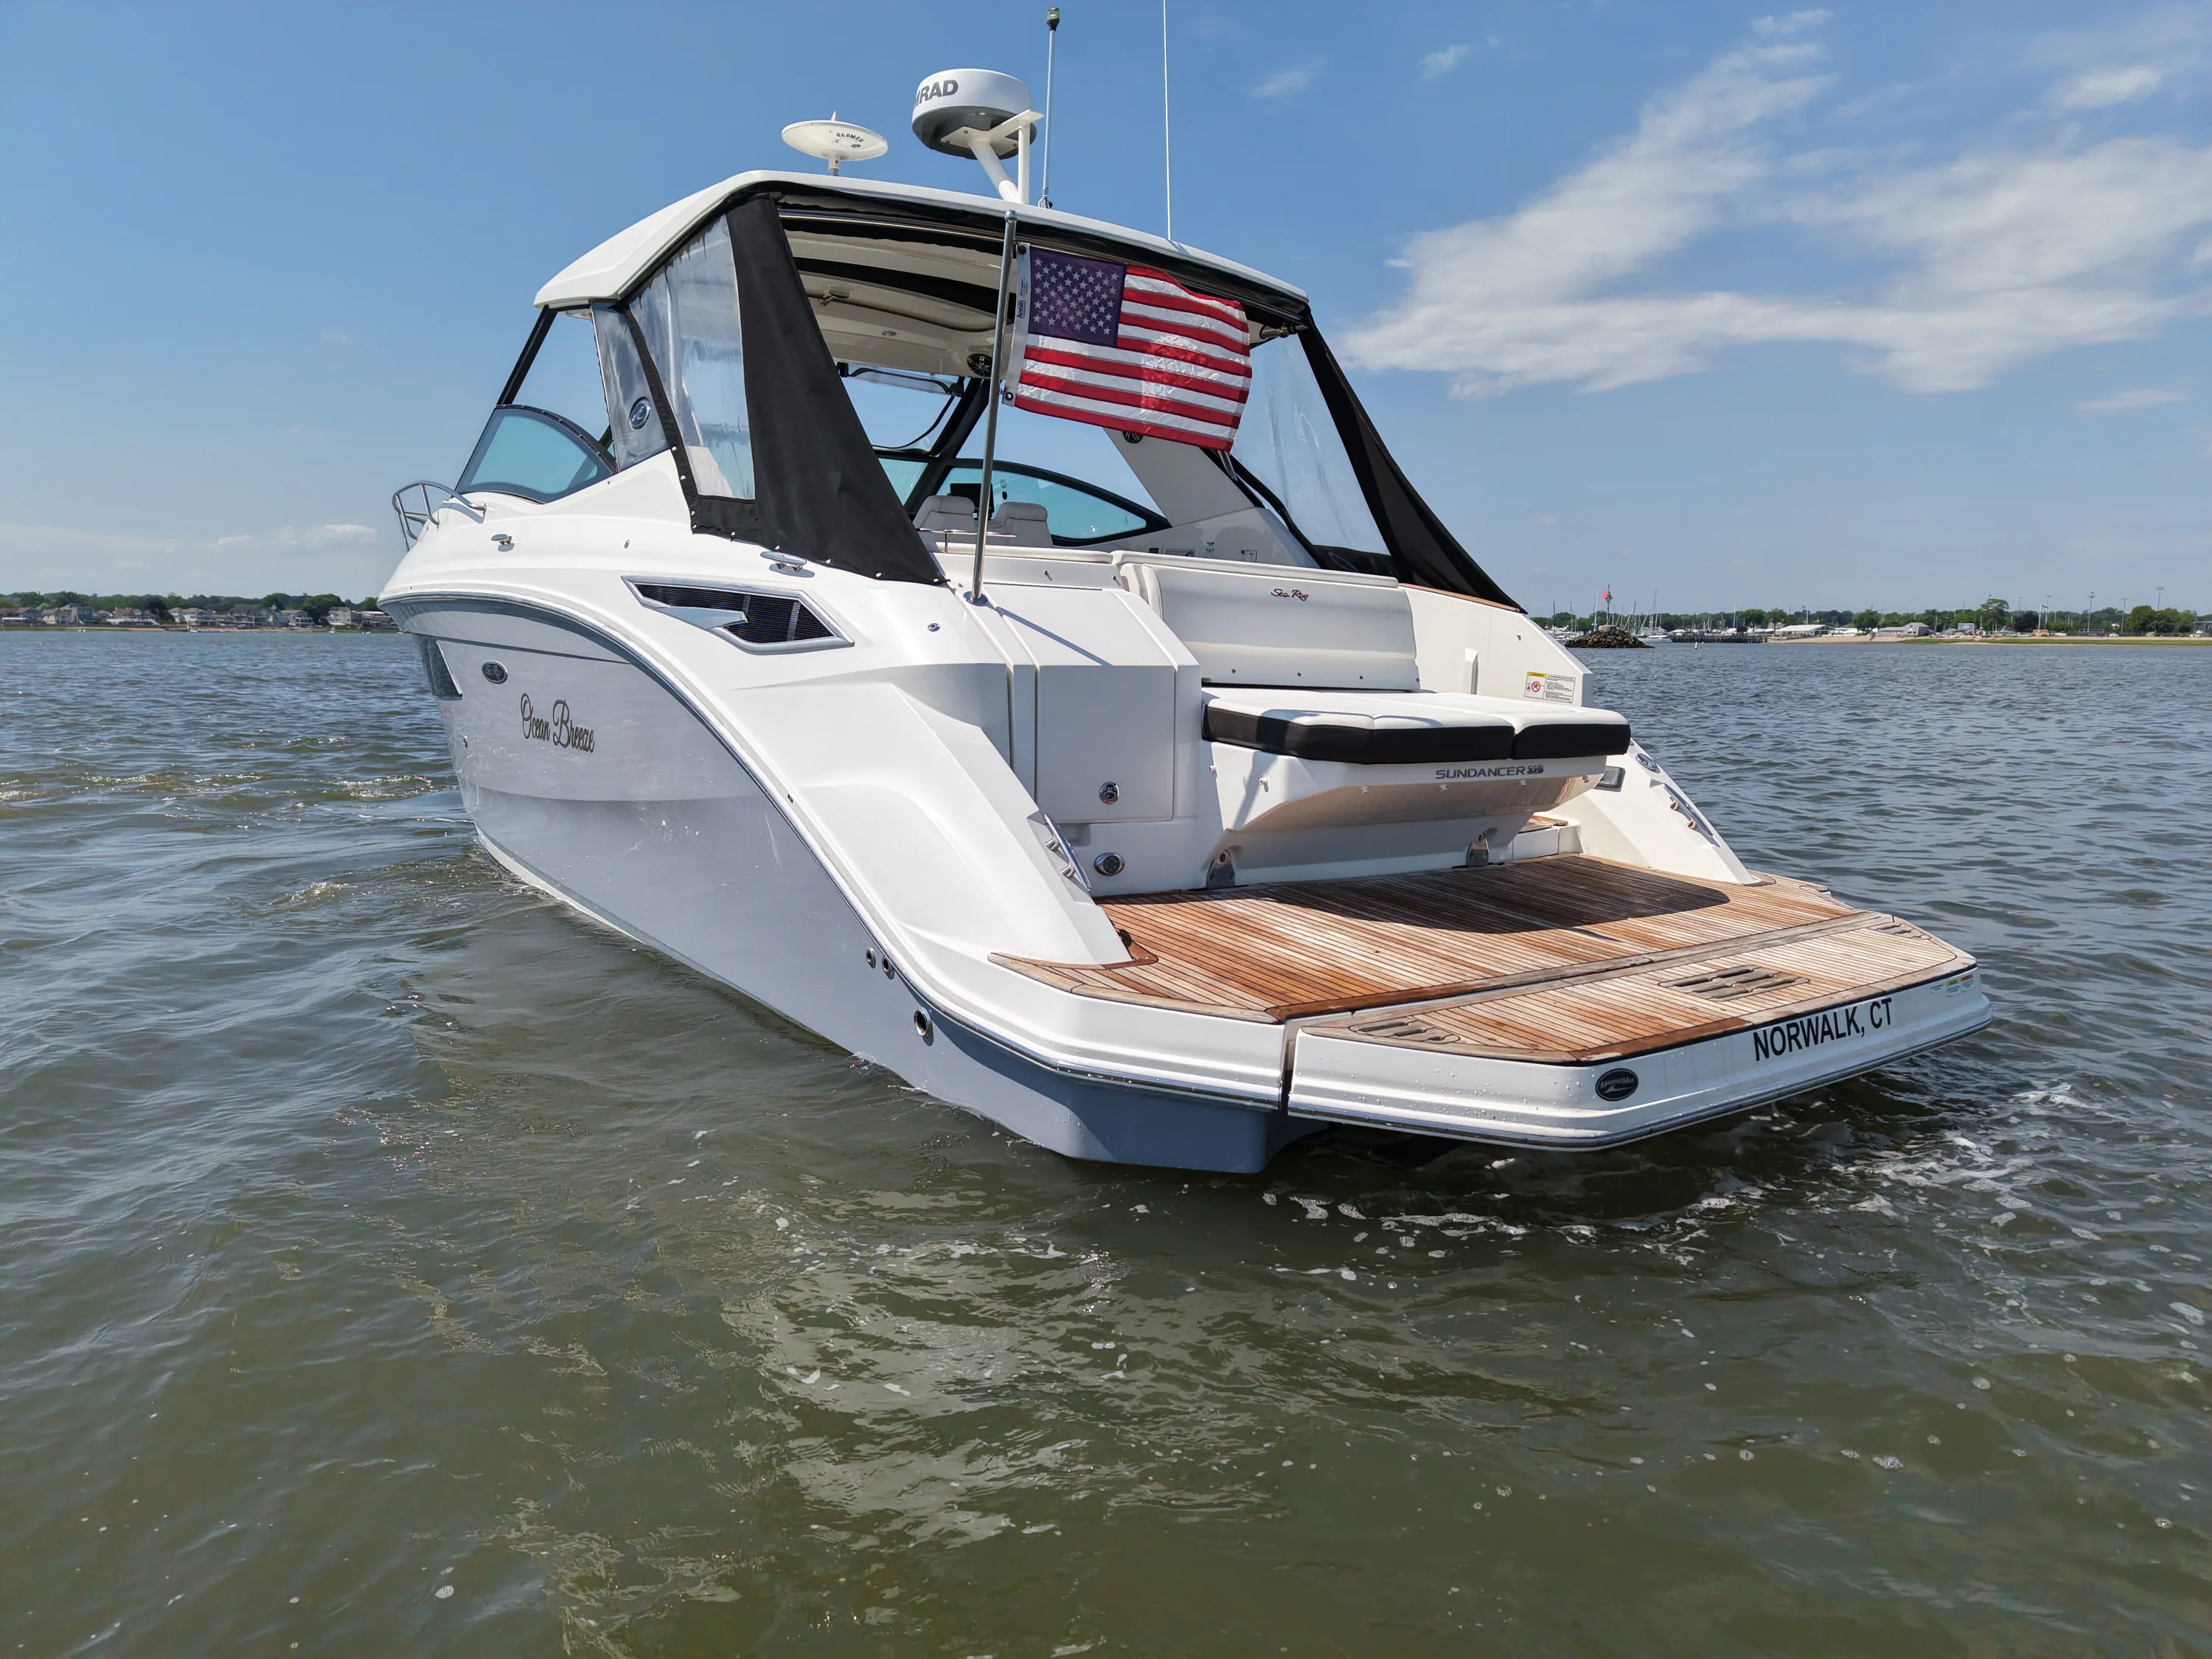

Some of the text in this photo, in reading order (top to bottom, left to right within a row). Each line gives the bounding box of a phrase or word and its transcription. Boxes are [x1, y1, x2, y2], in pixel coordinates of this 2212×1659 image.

[836, 133, 864, 142] GLOMEX
[1270, 588, 1309, 601] Sea Ray
[521, 693, 595, 753] Ocean Breeze
[1436, 766, 1526, 779] SUNDANCER
[1753, 998, 1893, 1062] NORWALK, CT
